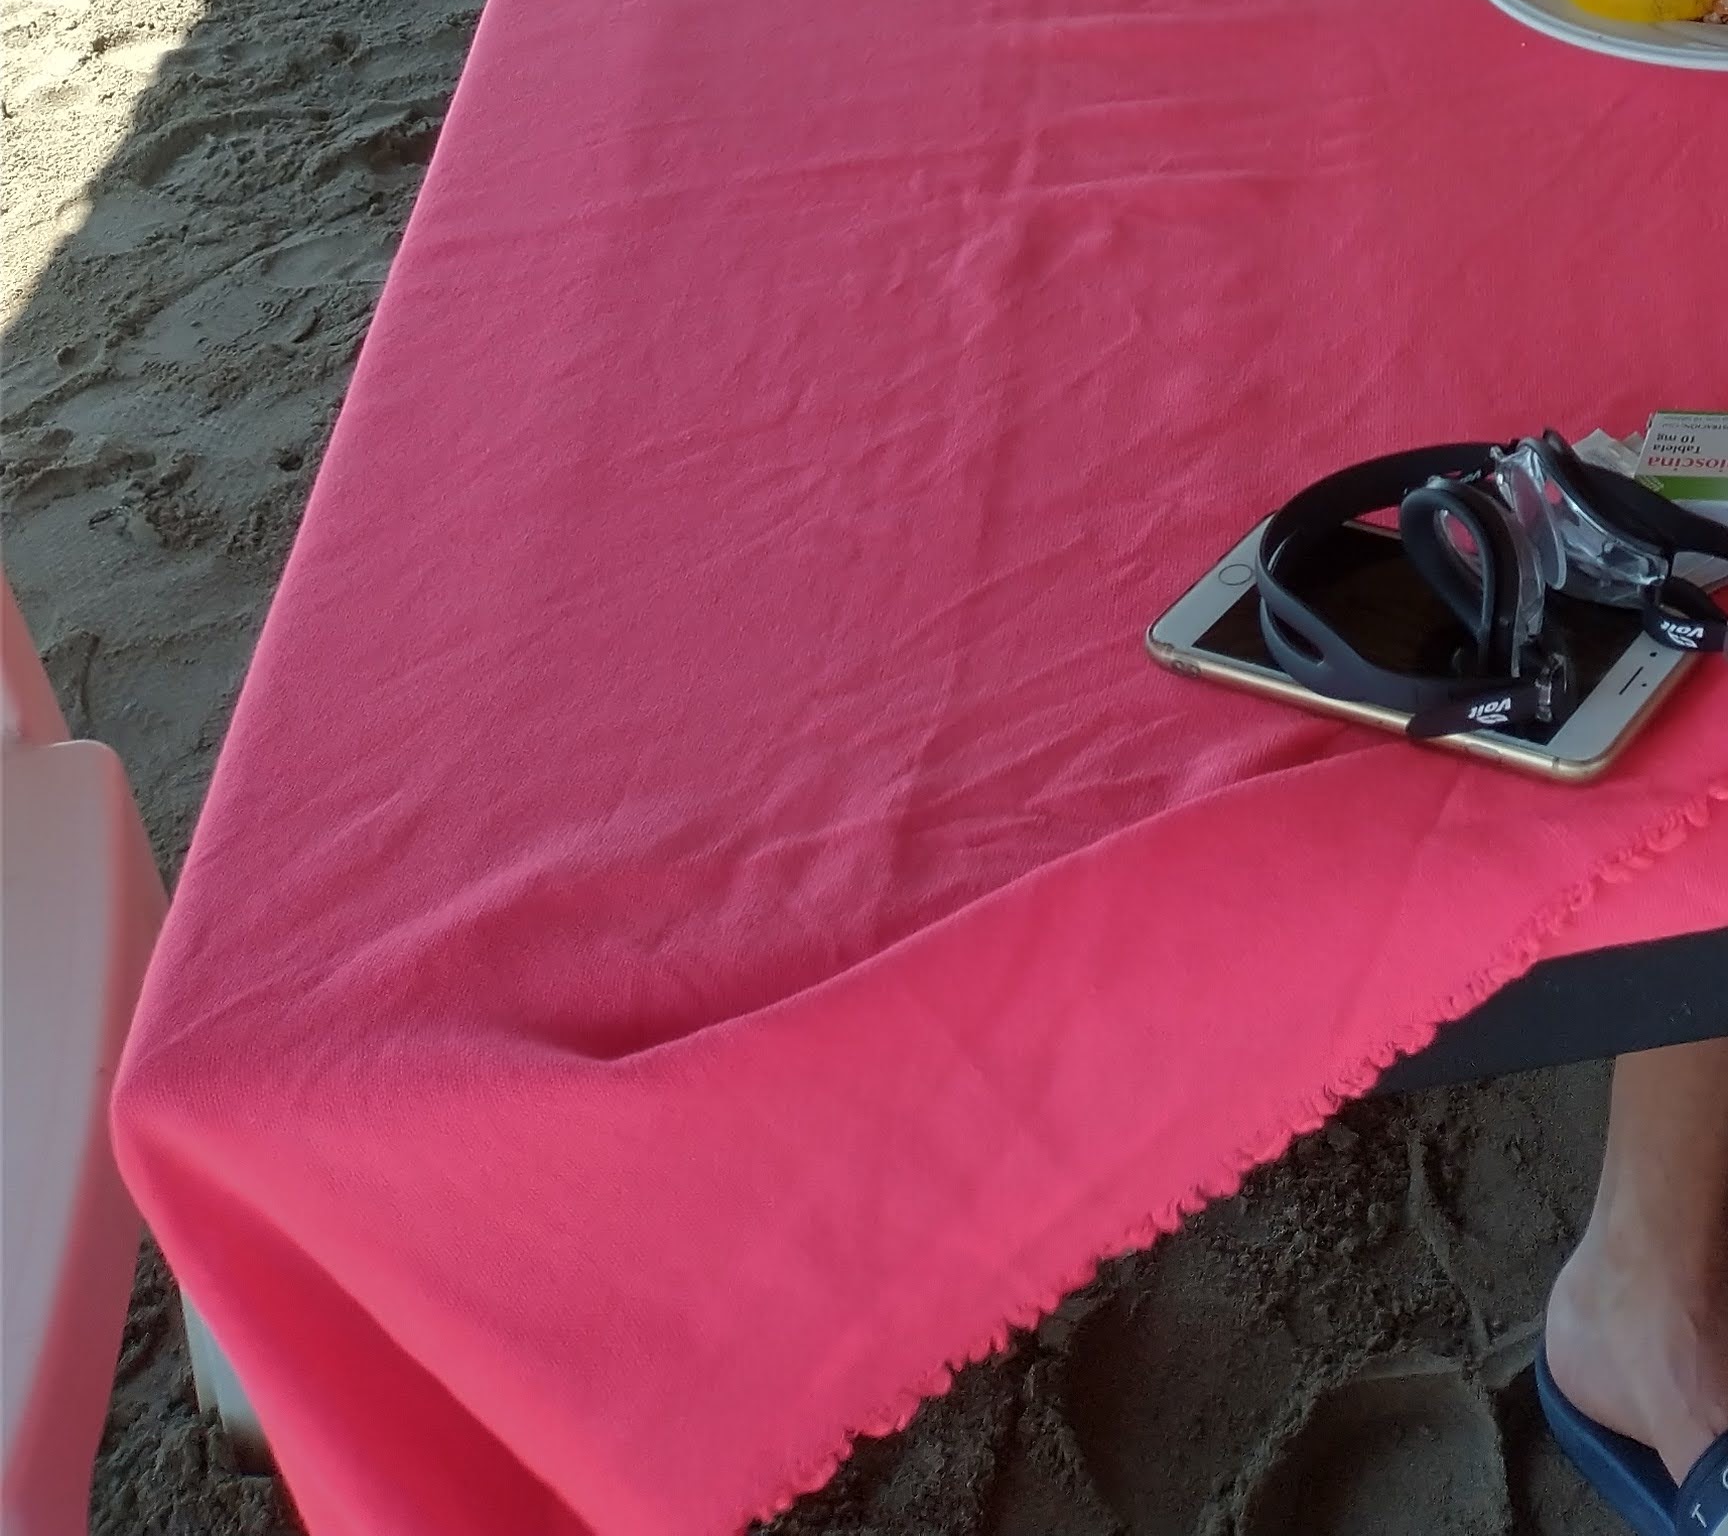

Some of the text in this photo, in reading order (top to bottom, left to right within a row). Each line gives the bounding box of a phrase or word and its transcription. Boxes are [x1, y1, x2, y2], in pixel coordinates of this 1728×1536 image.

[1656, 432, 1695, 444] 10 mg
[1653, 444, 1701, 455] Tableta
[1660, 620, 1704, 639] Voit
[1468, 697, 1511, 719] Voit
